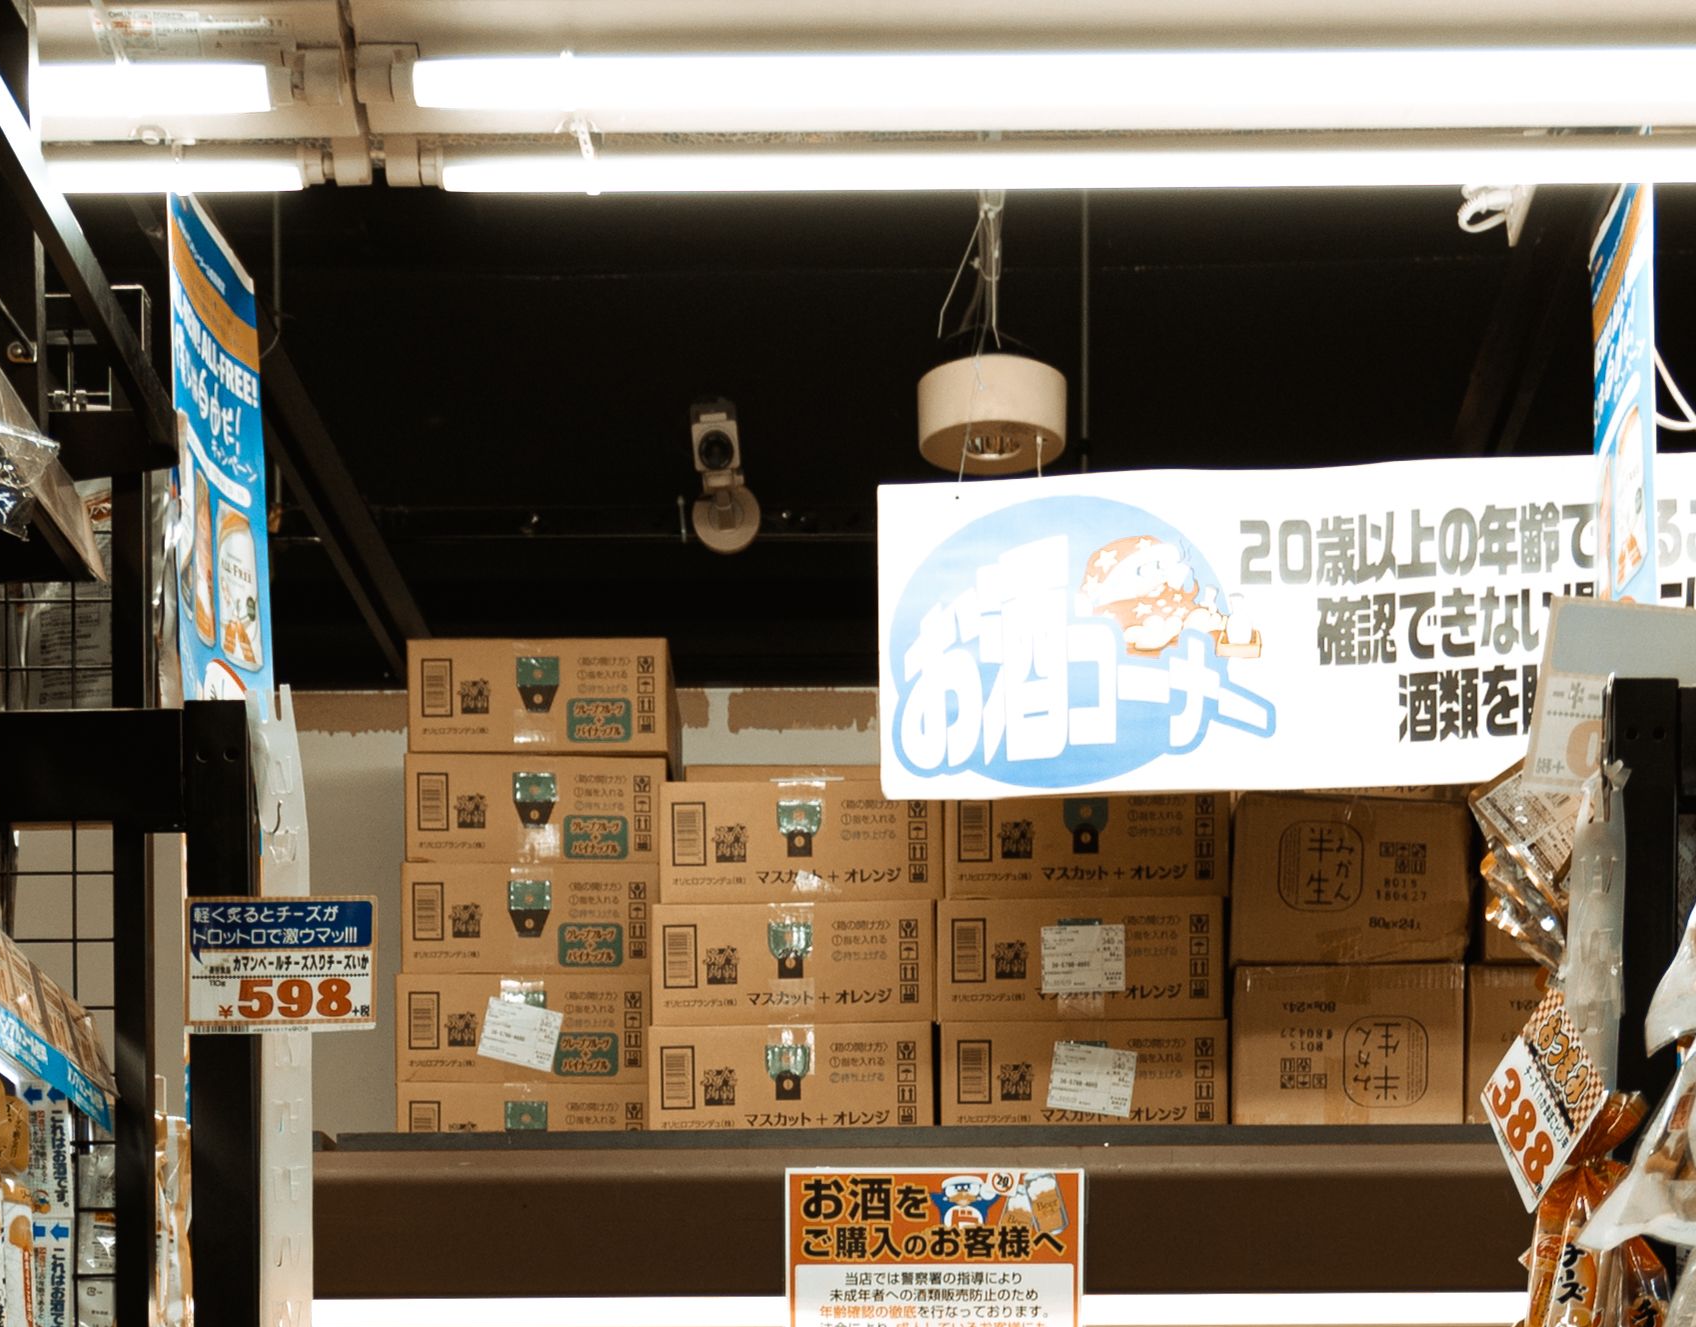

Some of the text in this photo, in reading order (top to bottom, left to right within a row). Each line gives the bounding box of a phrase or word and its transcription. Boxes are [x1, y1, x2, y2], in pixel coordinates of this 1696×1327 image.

[902, 535, 1274, 765] お酒コーナー
[1041, 864, 1189, 882] マスカット オレンジ
[1307, 825, 1332, 906] 半生
[194, 905, 339, 923] 軽く炙るとチーズが
[193, 927, 357, 945] トロットロで激ウマッ!!!
[233, 954, 369, 972] カマンベールチーズ入りチーズいか
[835, 988, 892, 1005] オレンジ
[352, 1005, 370, 1018] +税
[744, 1109, 891, 1128] マスカット オレンジ
[802, 1176, 929, 1221] お酒を
[802, 1226, 1066, 1259] ご購入のお客様へ
[844, 1271, 1023, 1286] 当店では警察署の指導により
[829, 1289, 1039, 1302] 未成年者への酒類販売防止のため
[819, 1305, 1049, 1320] 年齢確認の徹底を行なっております。
